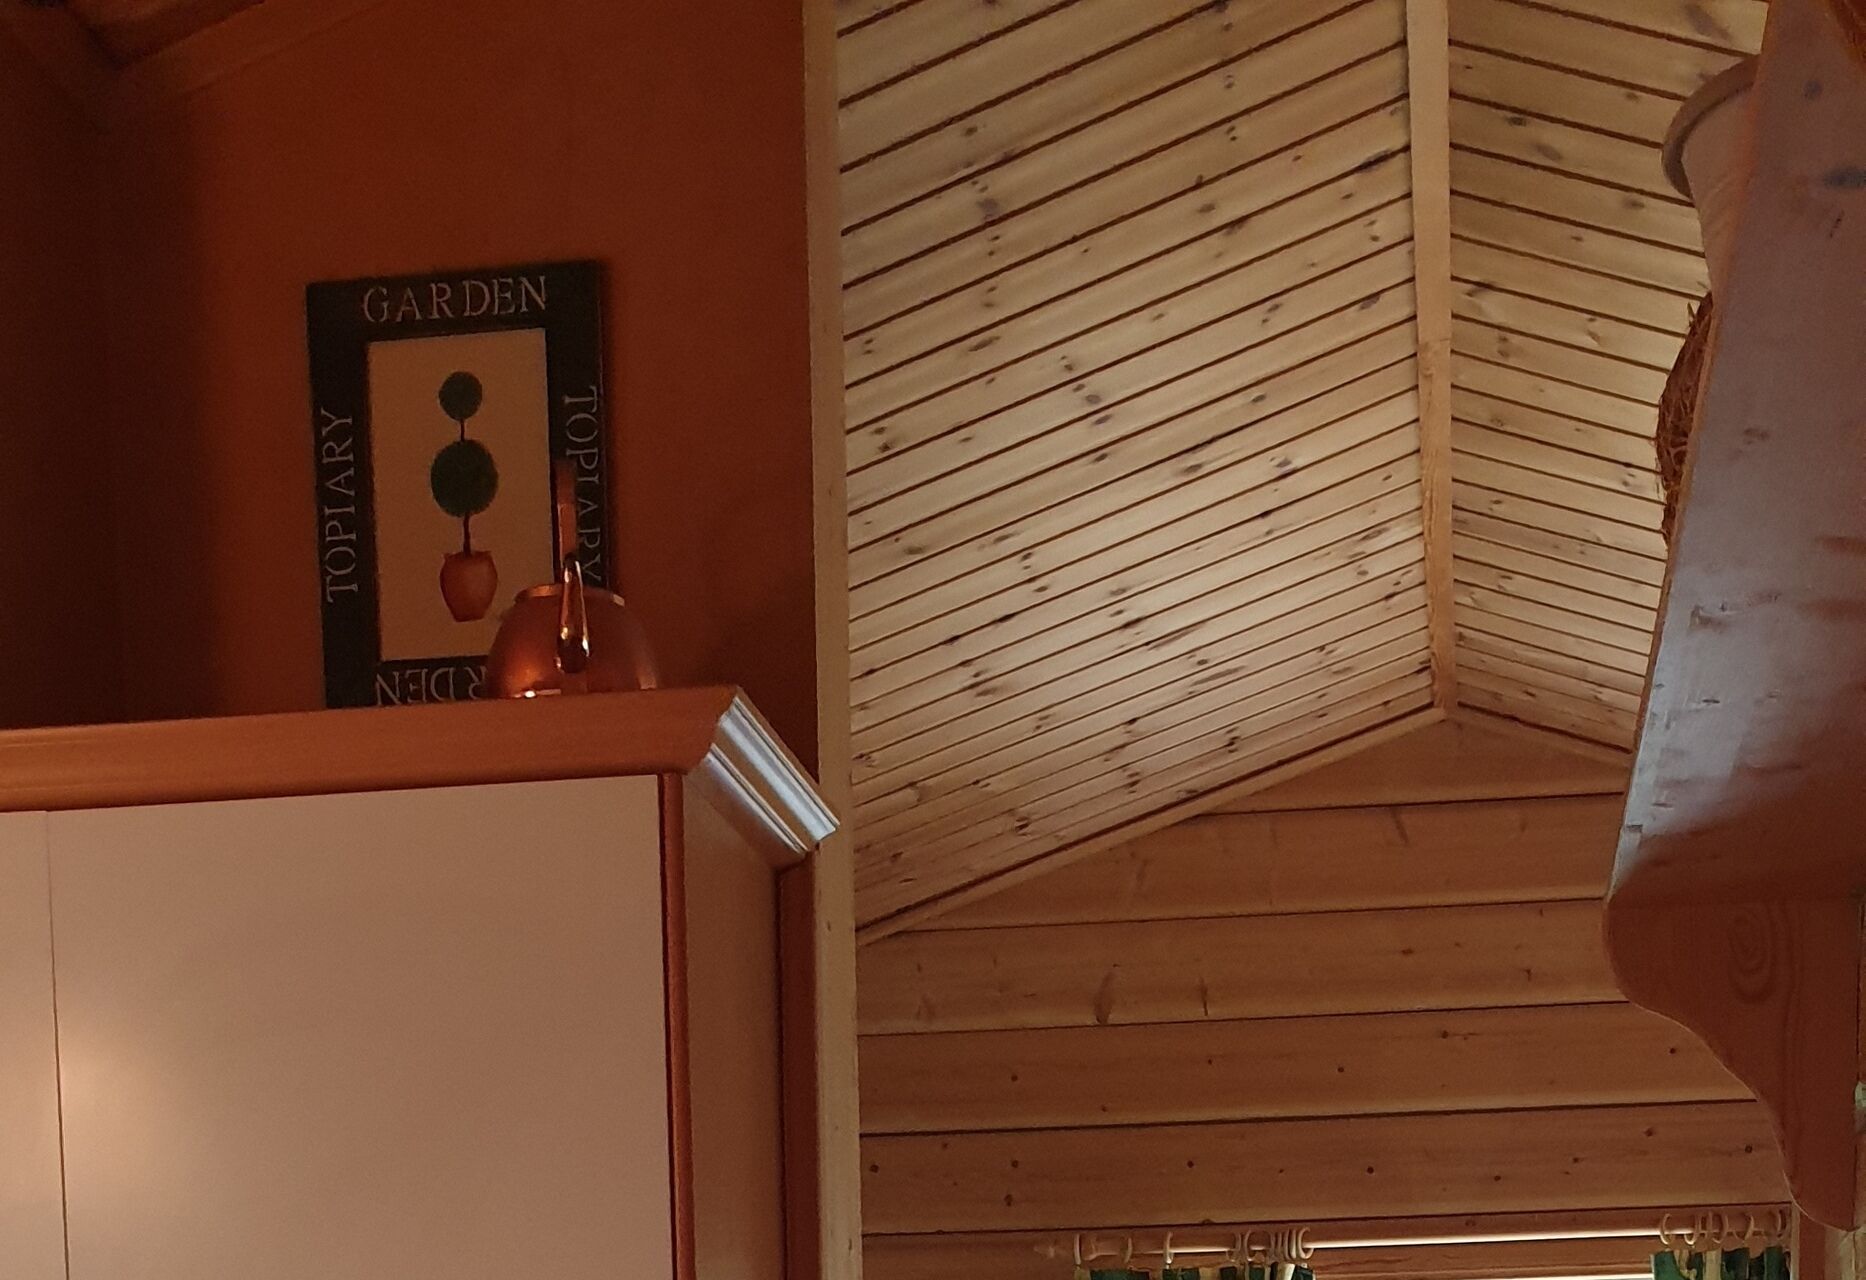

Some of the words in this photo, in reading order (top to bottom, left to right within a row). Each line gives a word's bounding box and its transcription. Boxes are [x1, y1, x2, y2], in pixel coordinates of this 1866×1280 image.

[362, 275, 547, 323] GARDEN
[320, 407, 359, 604] TOPIARY
[375, 665, 488, 706] RDEN
